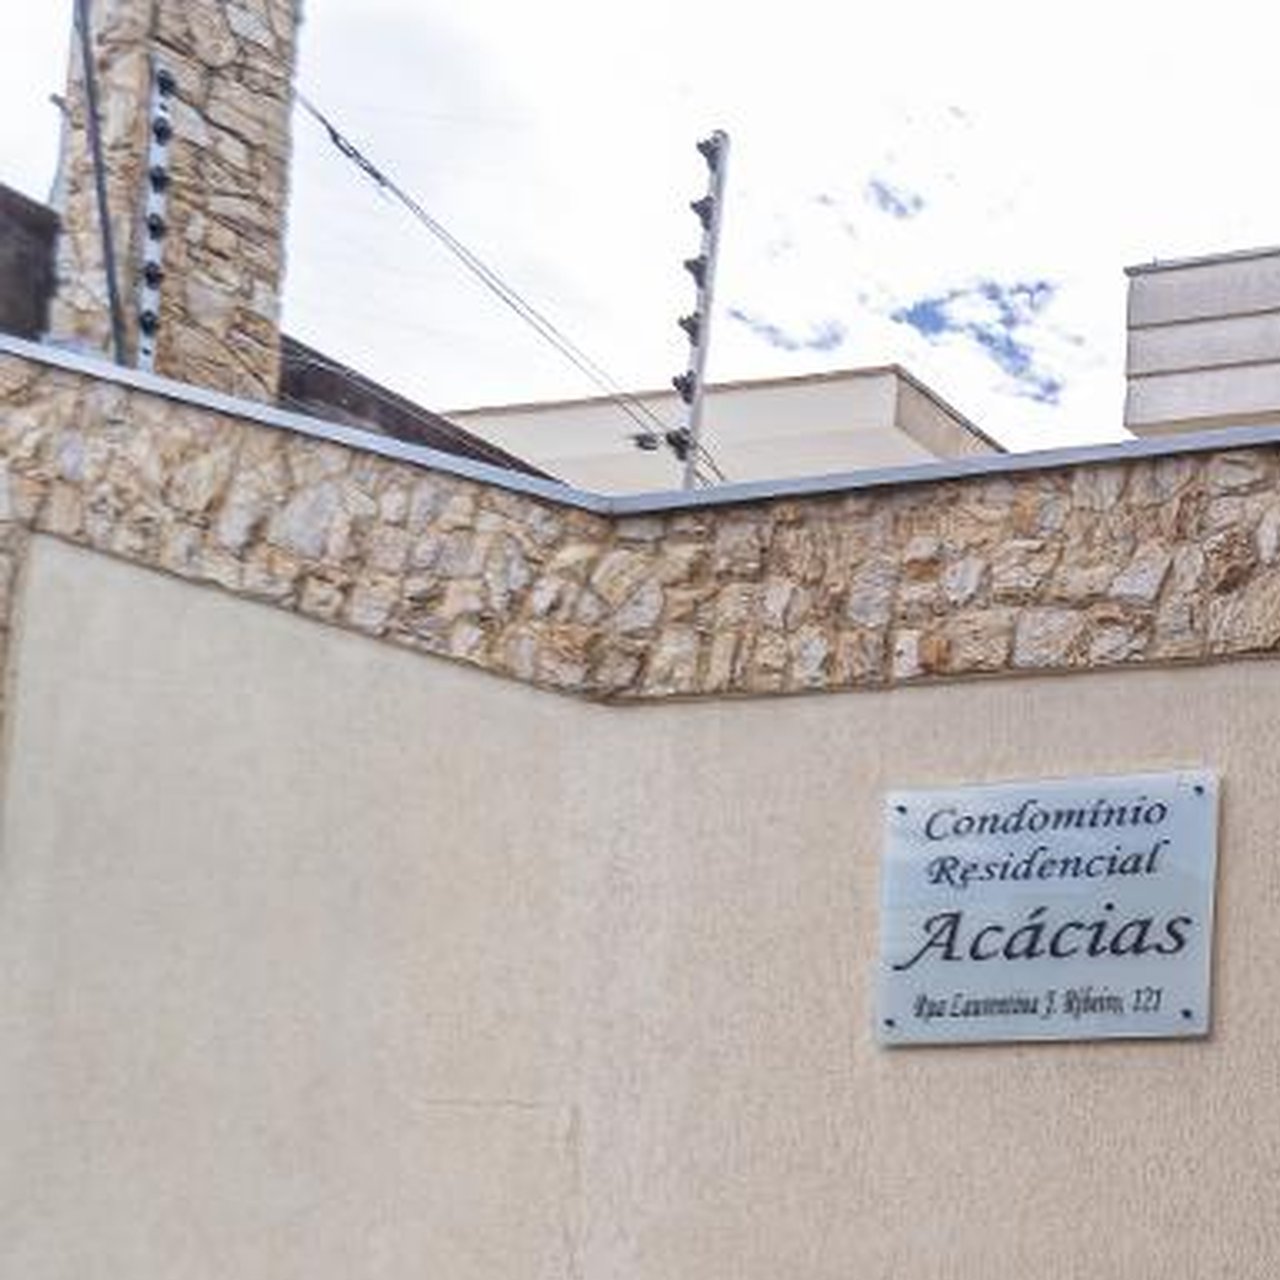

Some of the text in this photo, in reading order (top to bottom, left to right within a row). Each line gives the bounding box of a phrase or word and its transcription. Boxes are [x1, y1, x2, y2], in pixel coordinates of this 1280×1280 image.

[924, 796, 1168, 841] Condomínio
[927, 839, 1170, 889] Residencial
[892, 902, 1193, 971] Acácias
[1132, 986, 1163, 1013] 121
